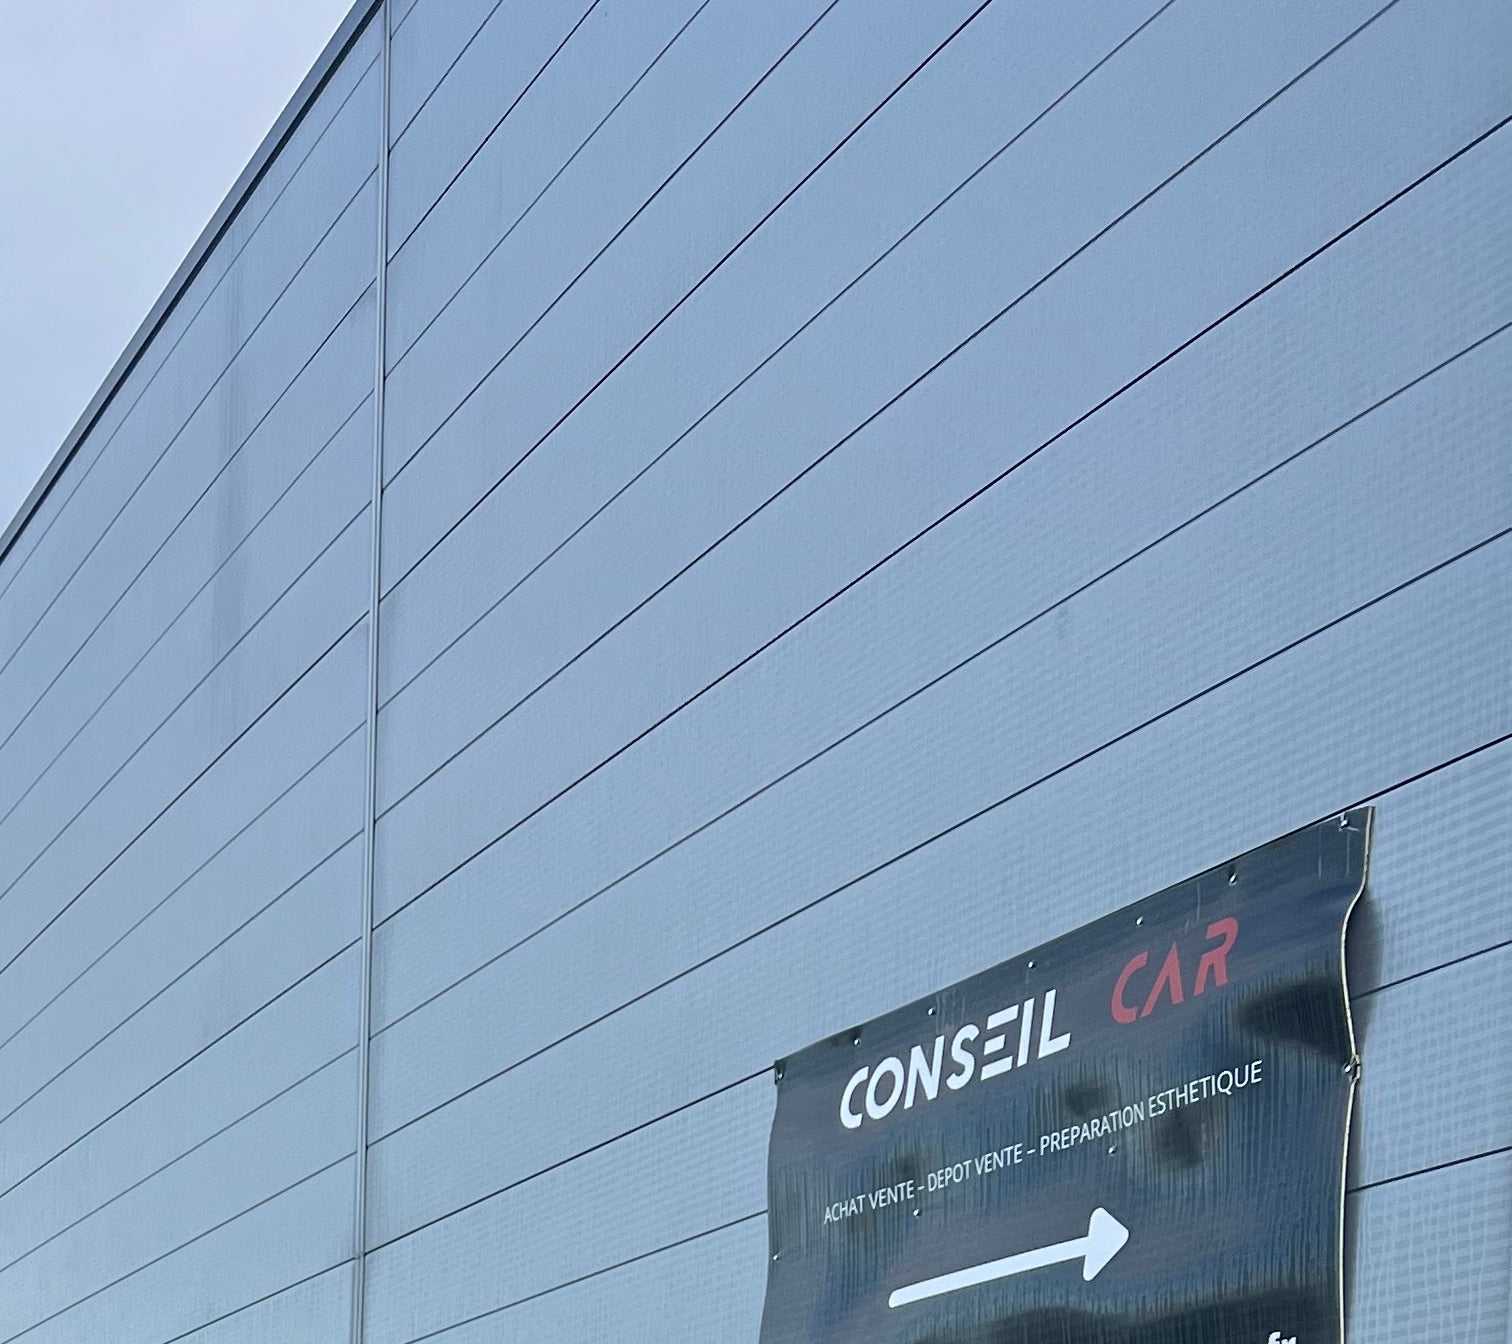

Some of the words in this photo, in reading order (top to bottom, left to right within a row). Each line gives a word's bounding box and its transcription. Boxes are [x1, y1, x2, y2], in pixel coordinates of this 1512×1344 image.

[839, 988, 1072, 1130] CONSEIL
[1110, 916, 1239, 1025] CAR
[823, 1194, 866, 1225] ACHAT
[868, 1179, 915, 1210] VENTE
[927, 1159, 973, 1193] DEPOT
[974, 1143, 1023, 1176] VENTE
[1039, 1101, 1145, 1157] PREPARATION
[1148, 1059, 1264, 1119] ESTHETIQUE
